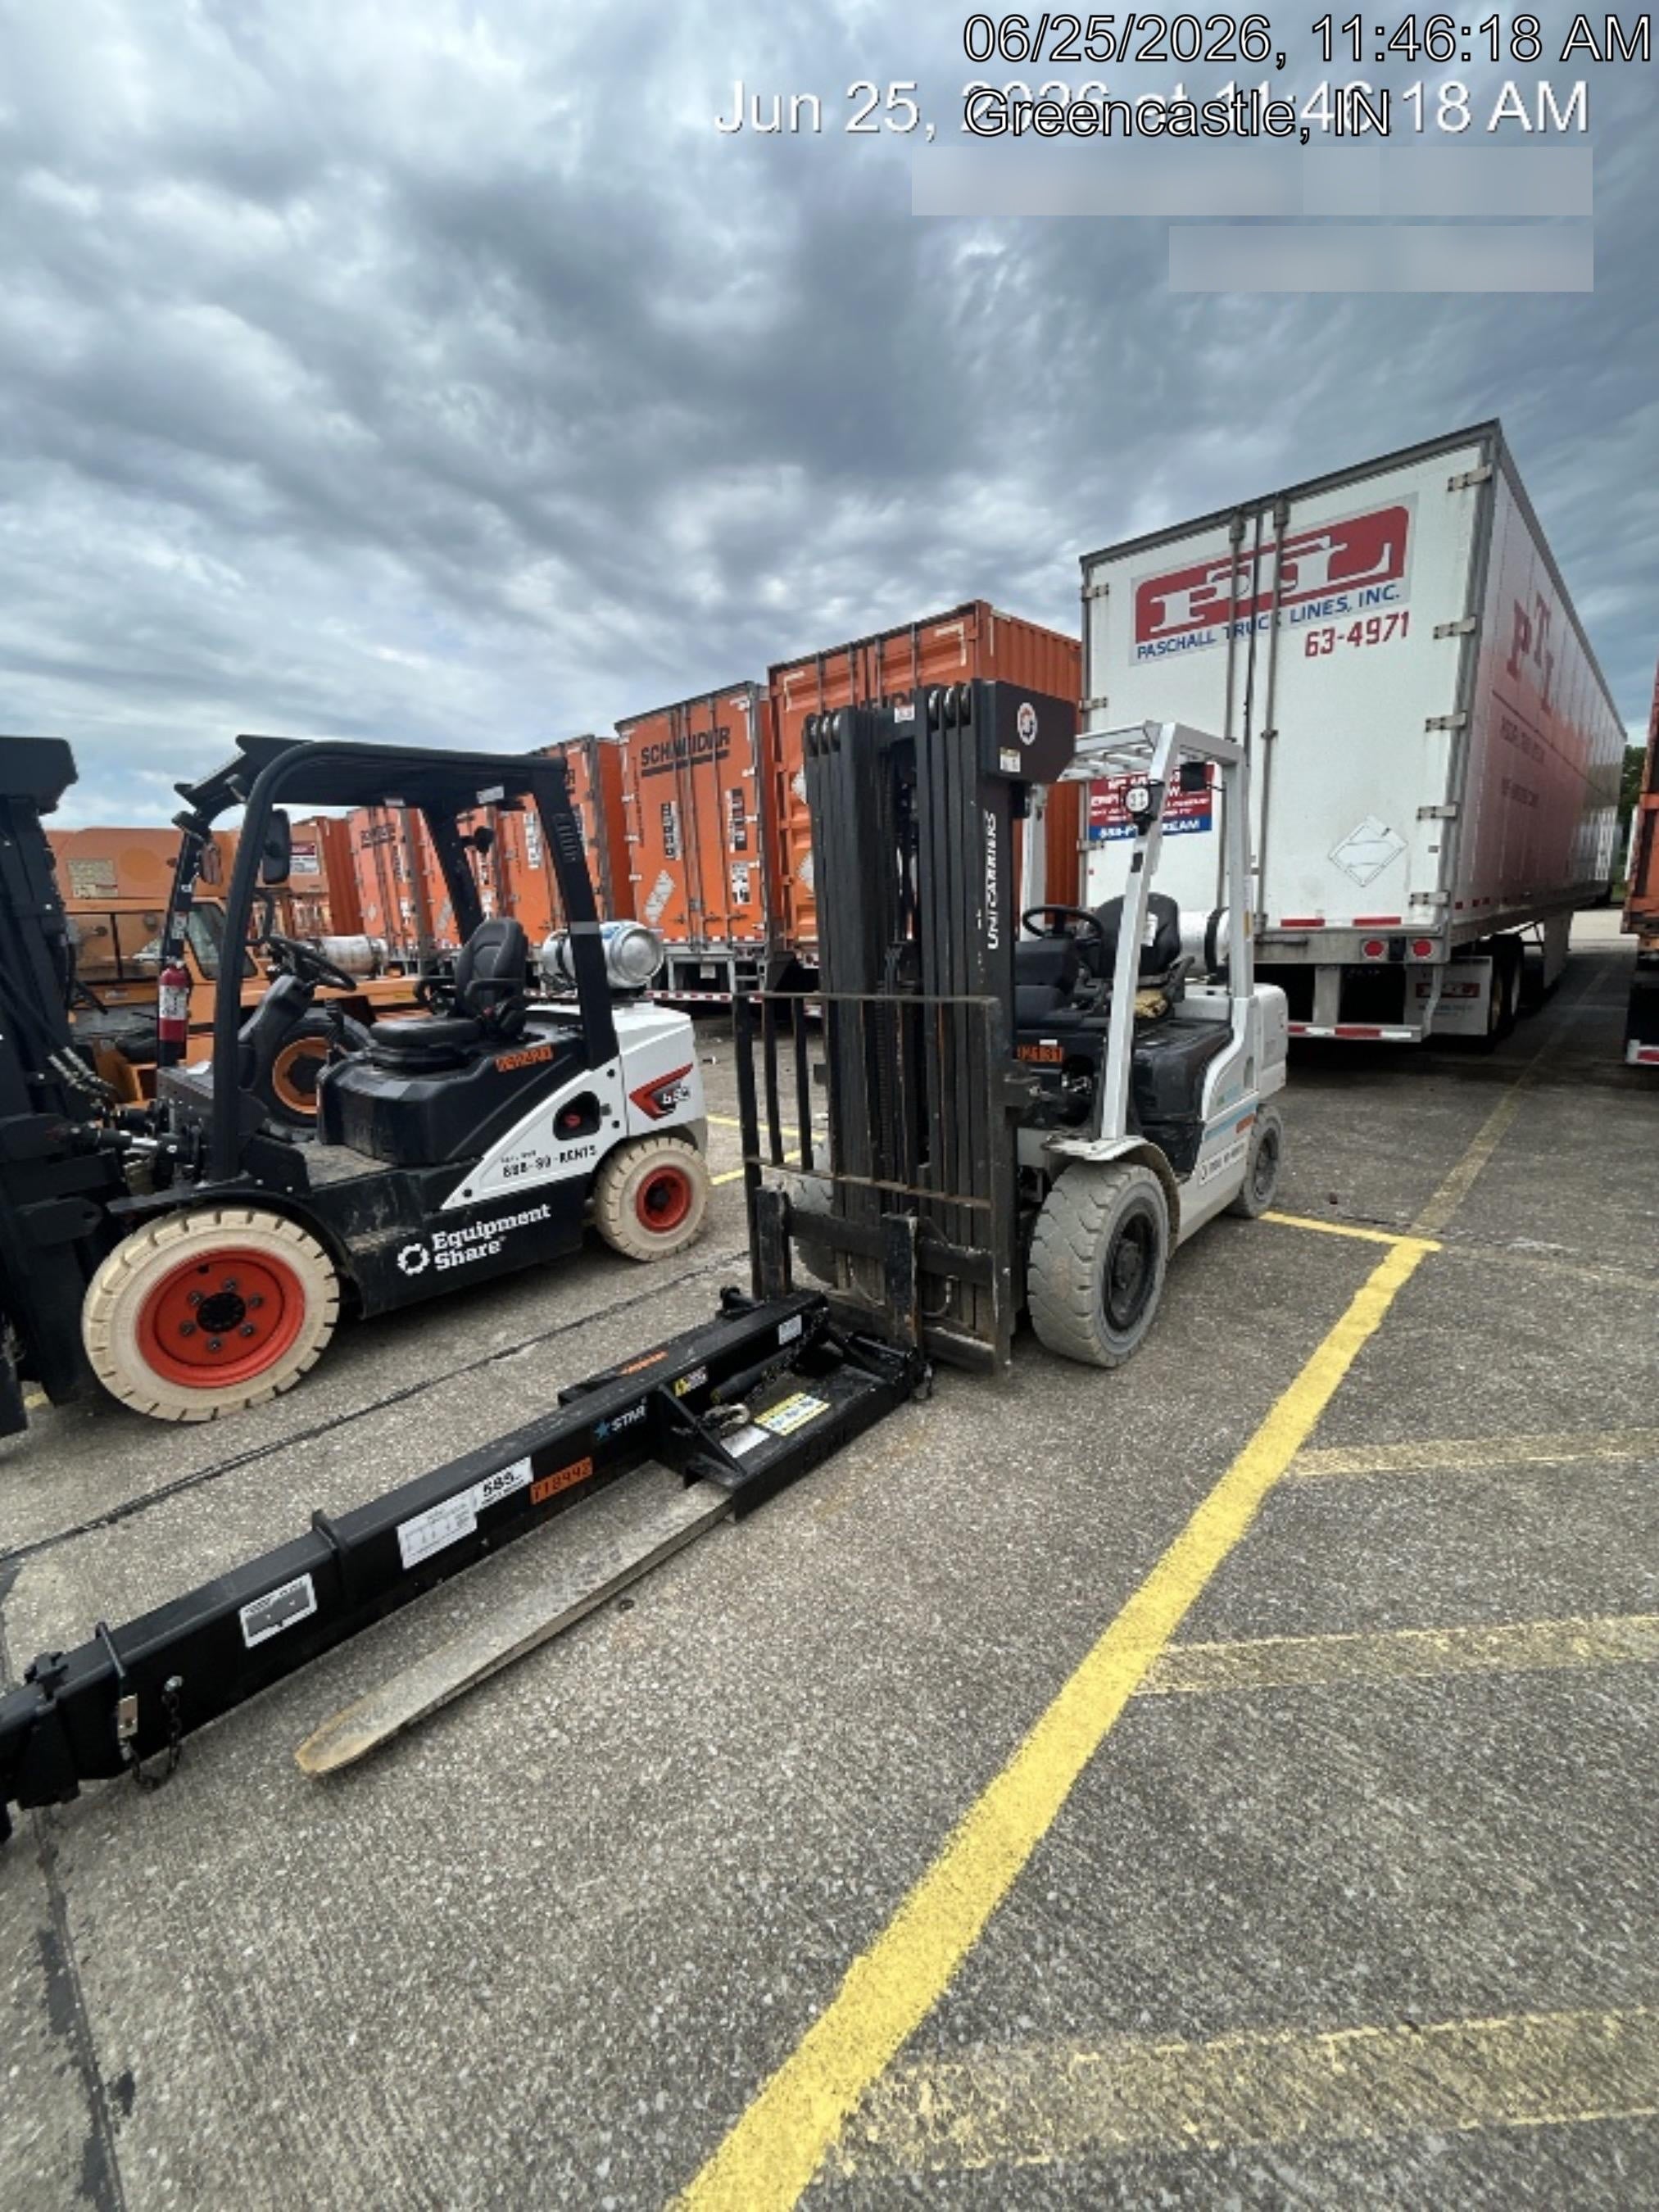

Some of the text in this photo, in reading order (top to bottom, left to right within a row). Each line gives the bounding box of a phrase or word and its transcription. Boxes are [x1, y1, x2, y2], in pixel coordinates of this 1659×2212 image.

[1136, 632, 1217, 660] PASCHALL
[1289, 599, 1353, 623] LINES,
[1358, 584, 1401, 609] INC.
[1304, 610, 1410, 659] 63-4971
[431, 1203, 551, 1252] Equipment
[433, 1240, 501, 1271] Share
